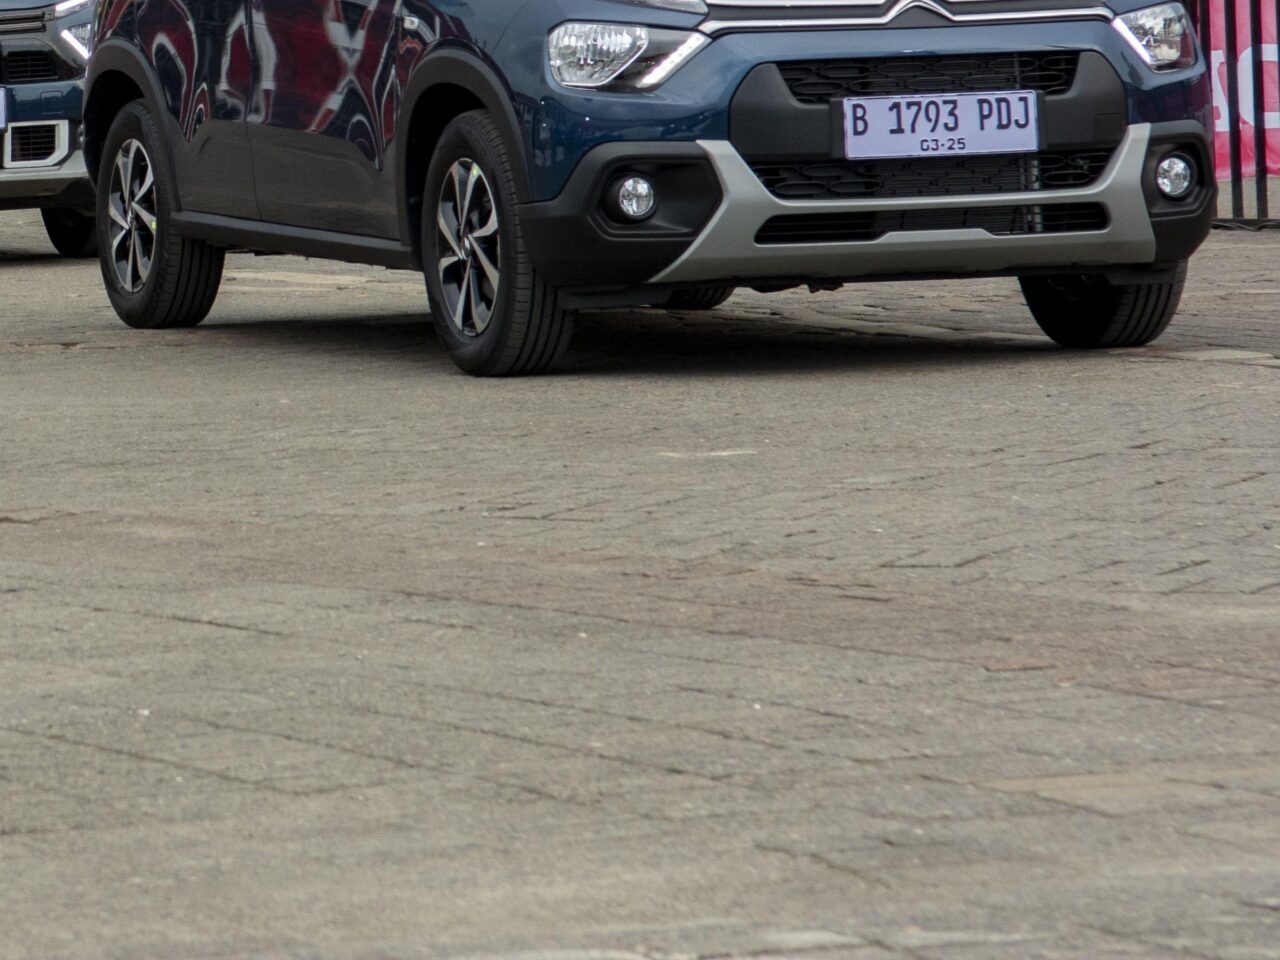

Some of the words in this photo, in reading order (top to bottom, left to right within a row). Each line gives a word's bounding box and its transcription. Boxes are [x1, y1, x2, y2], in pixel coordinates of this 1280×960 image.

[852, 103, 868, 136] B
[888, 99, 959, 135] 1793
[977, 96, 1030, 131] PDJ
